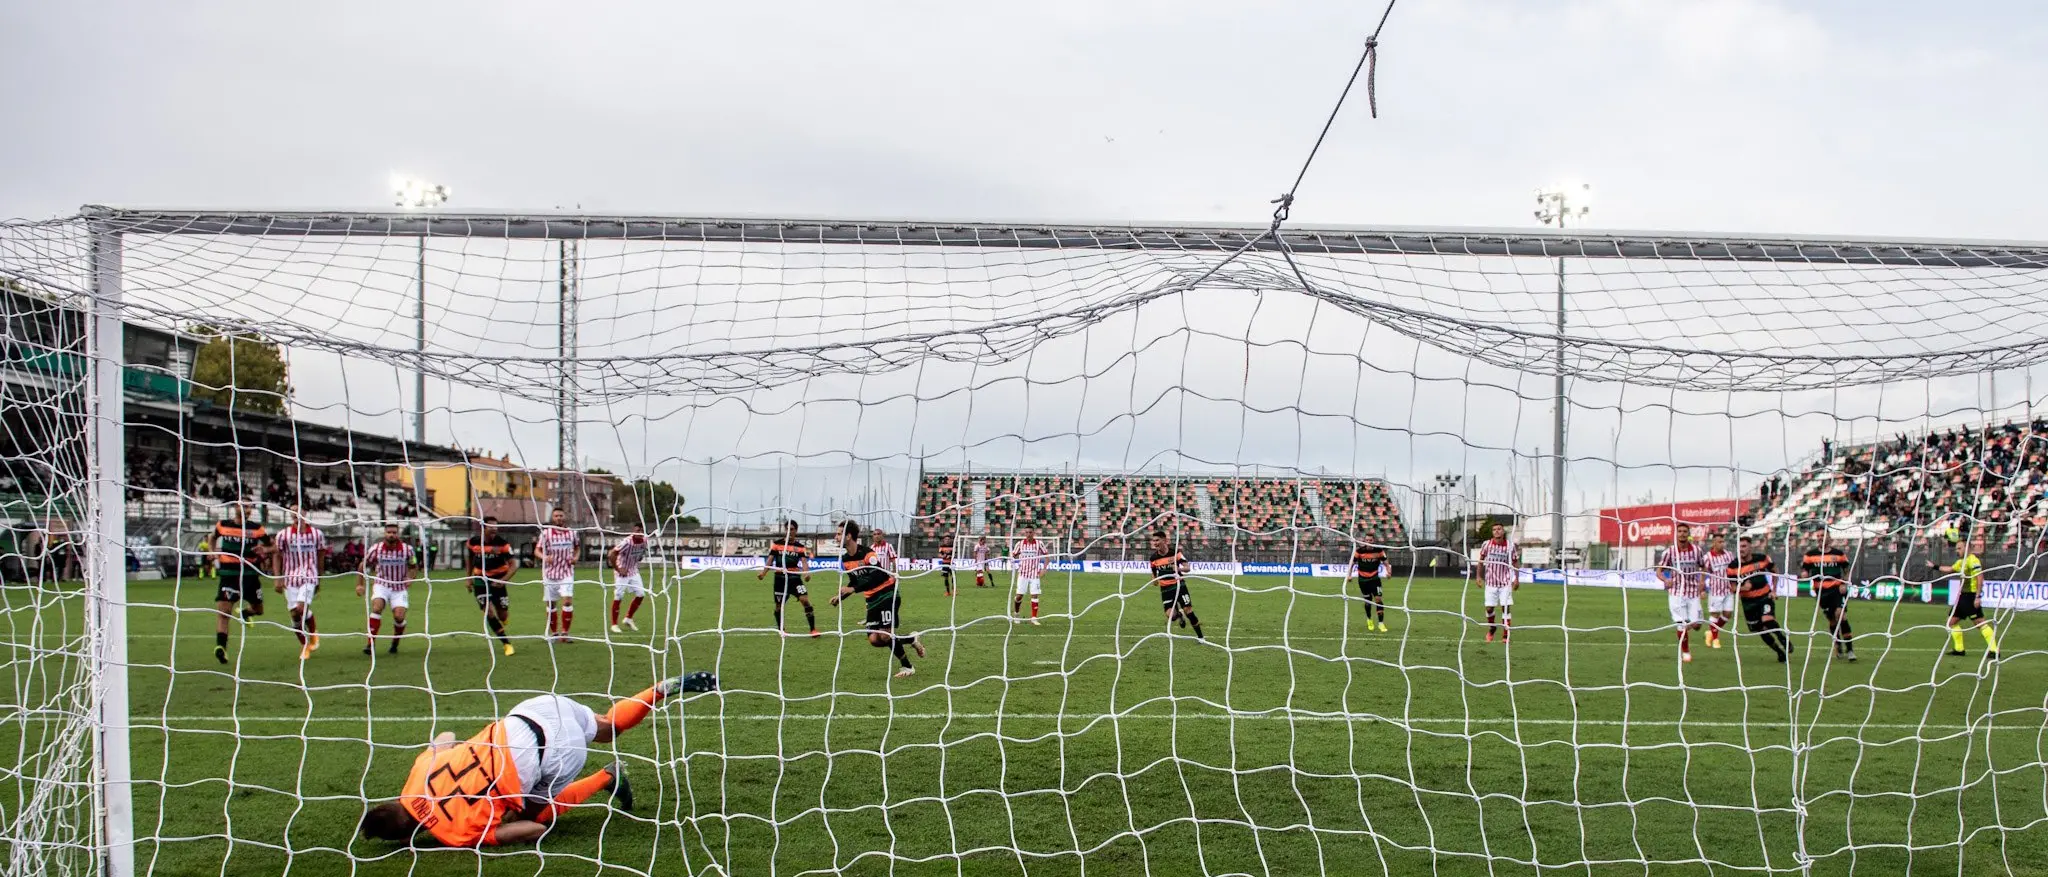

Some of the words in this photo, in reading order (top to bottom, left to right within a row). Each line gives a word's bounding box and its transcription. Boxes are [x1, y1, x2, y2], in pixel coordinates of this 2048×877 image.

[1640, 523, 1672, 536] vodafone
[687, 538, 710, 548] 60
[738, 540, 767, 548] SUNT
[1104, 561, 1151, 570] STEVANAT
[1243, 564, 1309, 574] stevanato.com
[881, 610, 892, 622] 10
